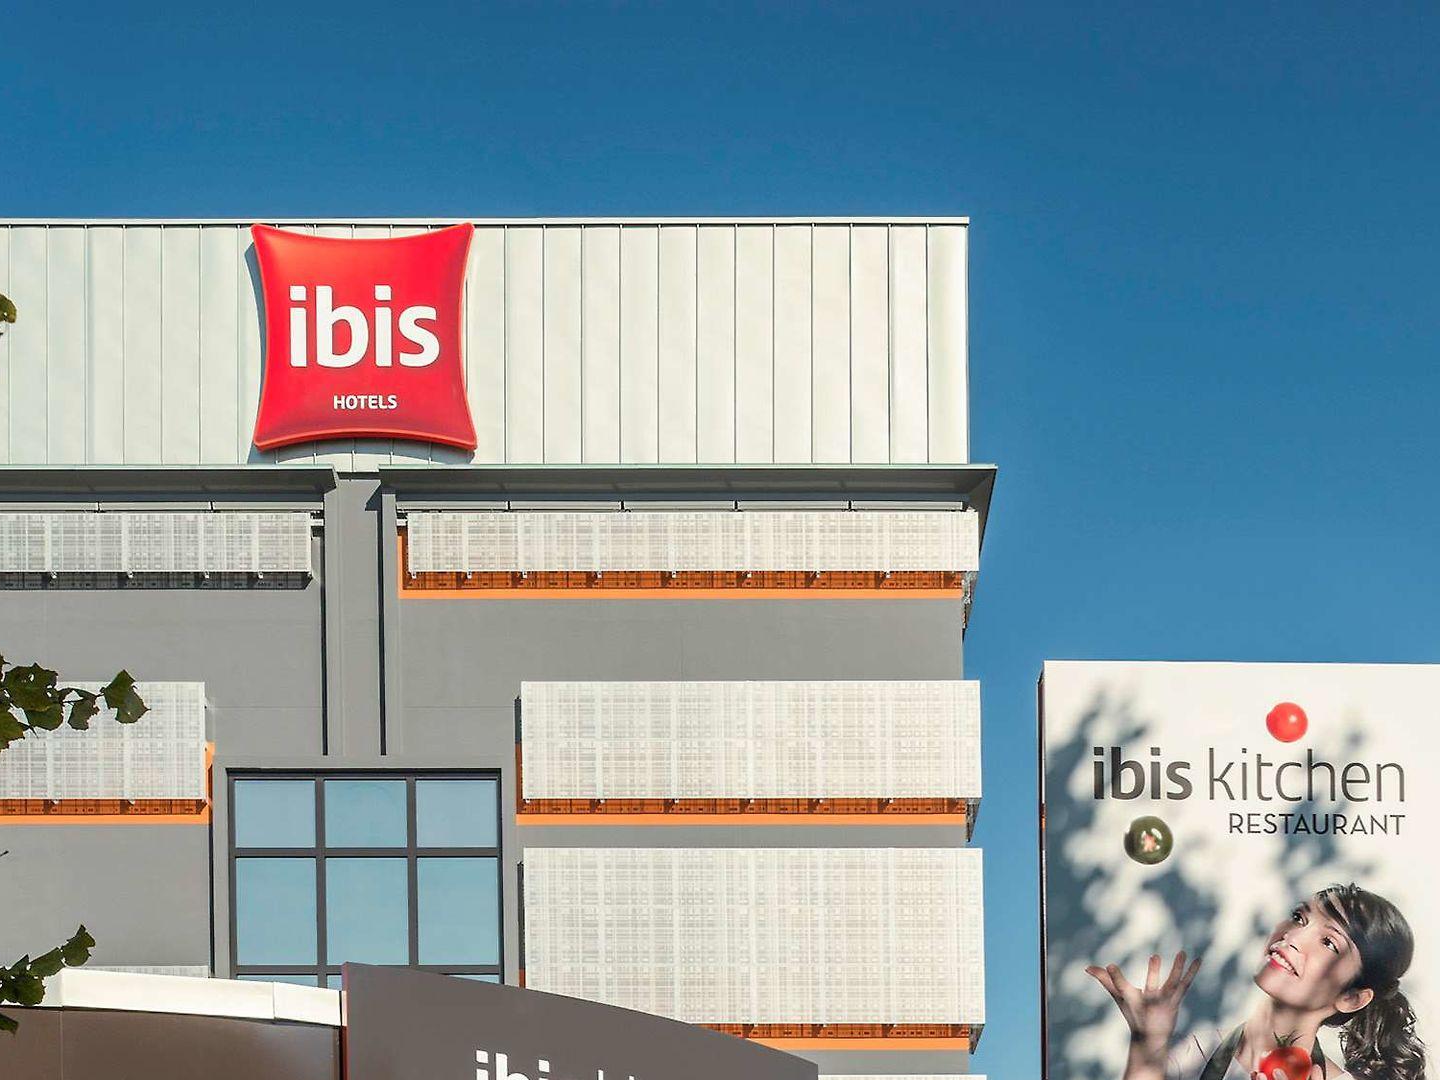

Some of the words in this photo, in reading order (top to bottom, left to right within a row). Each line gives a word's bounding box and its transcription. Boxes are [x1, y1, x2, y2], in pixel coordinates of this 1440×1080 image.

[289, 285, 440, 368] ibis
[333, 394, 398, 410] HOTELS
[1093, 746, 1193, 801] ibis
[1209, 747, 1406, 802] kitchen
[1229, 812, 1406, 836] RESTAURANT
